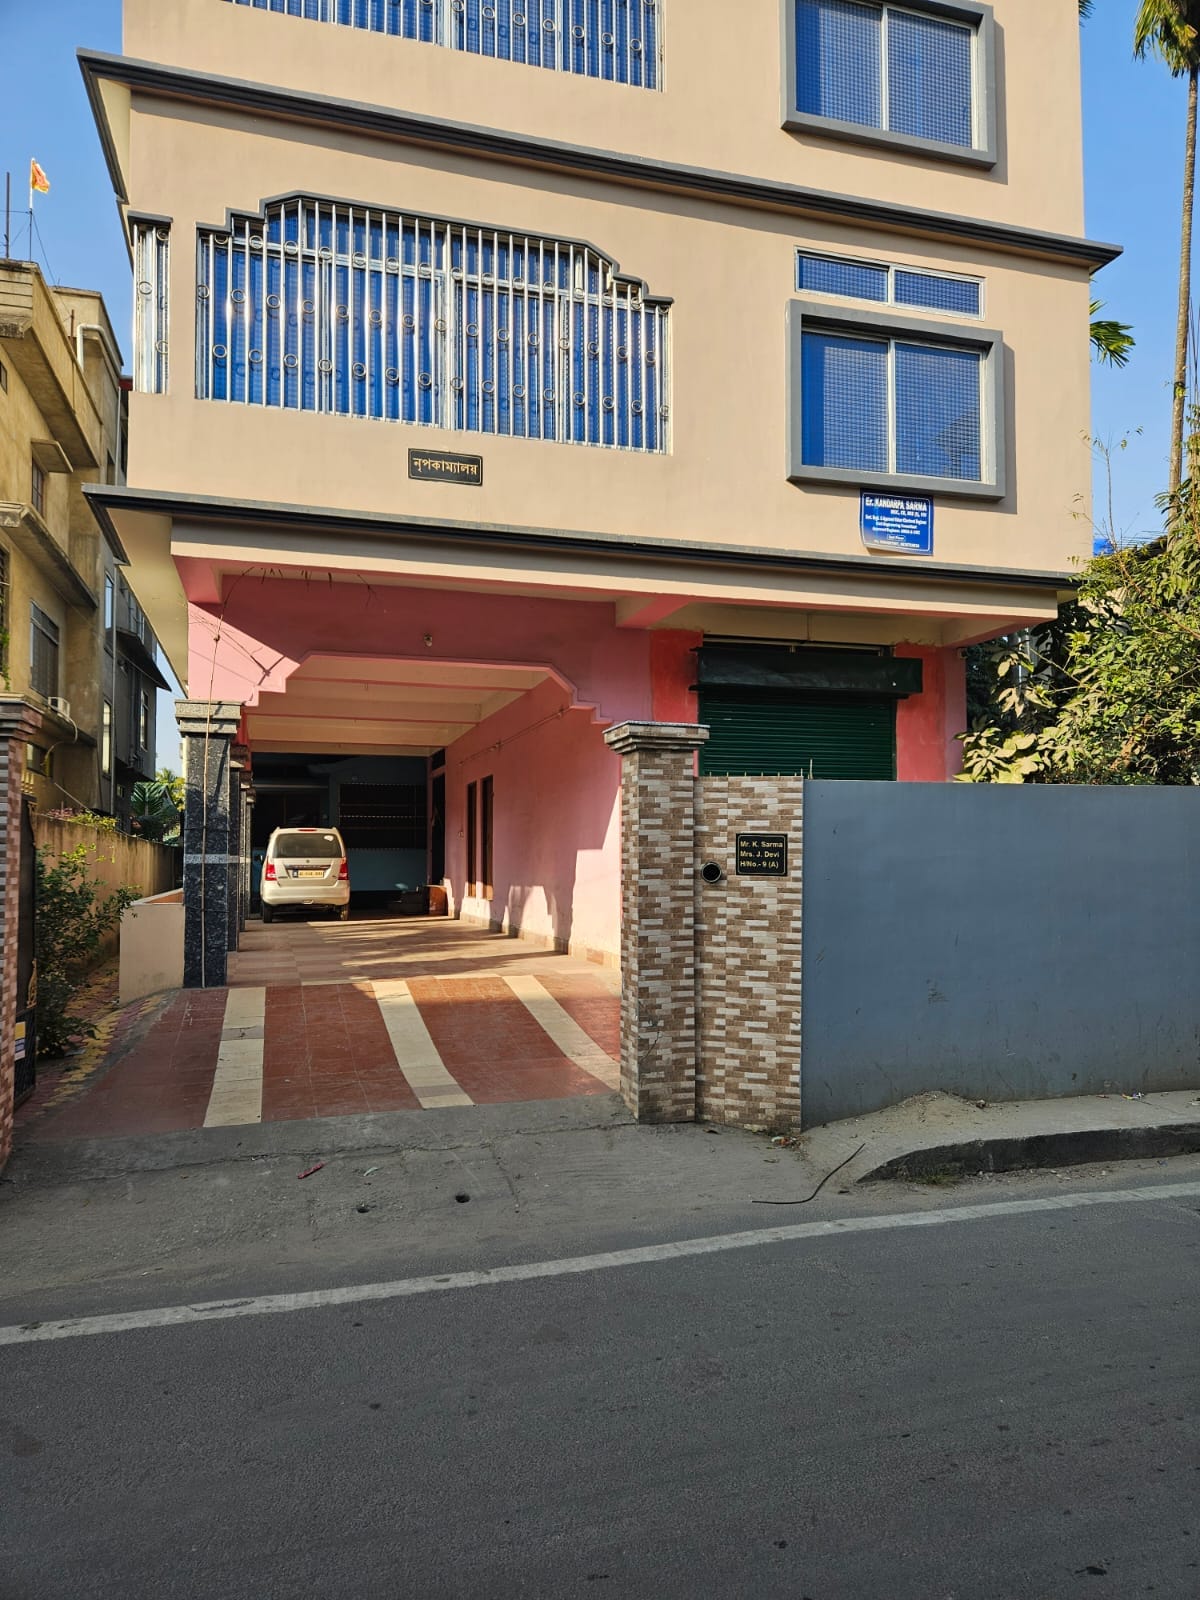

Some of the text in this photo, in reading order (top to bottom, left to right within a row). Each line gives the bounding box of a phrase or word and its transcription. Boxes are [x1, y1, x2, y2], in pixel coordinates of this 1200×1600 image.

[865, 496, 874, 506] Er.
[905, 500, 928, 511] SARMA
[740, 850, 755, 858] Mrs.
[768, 861, 779, 869] (A)
